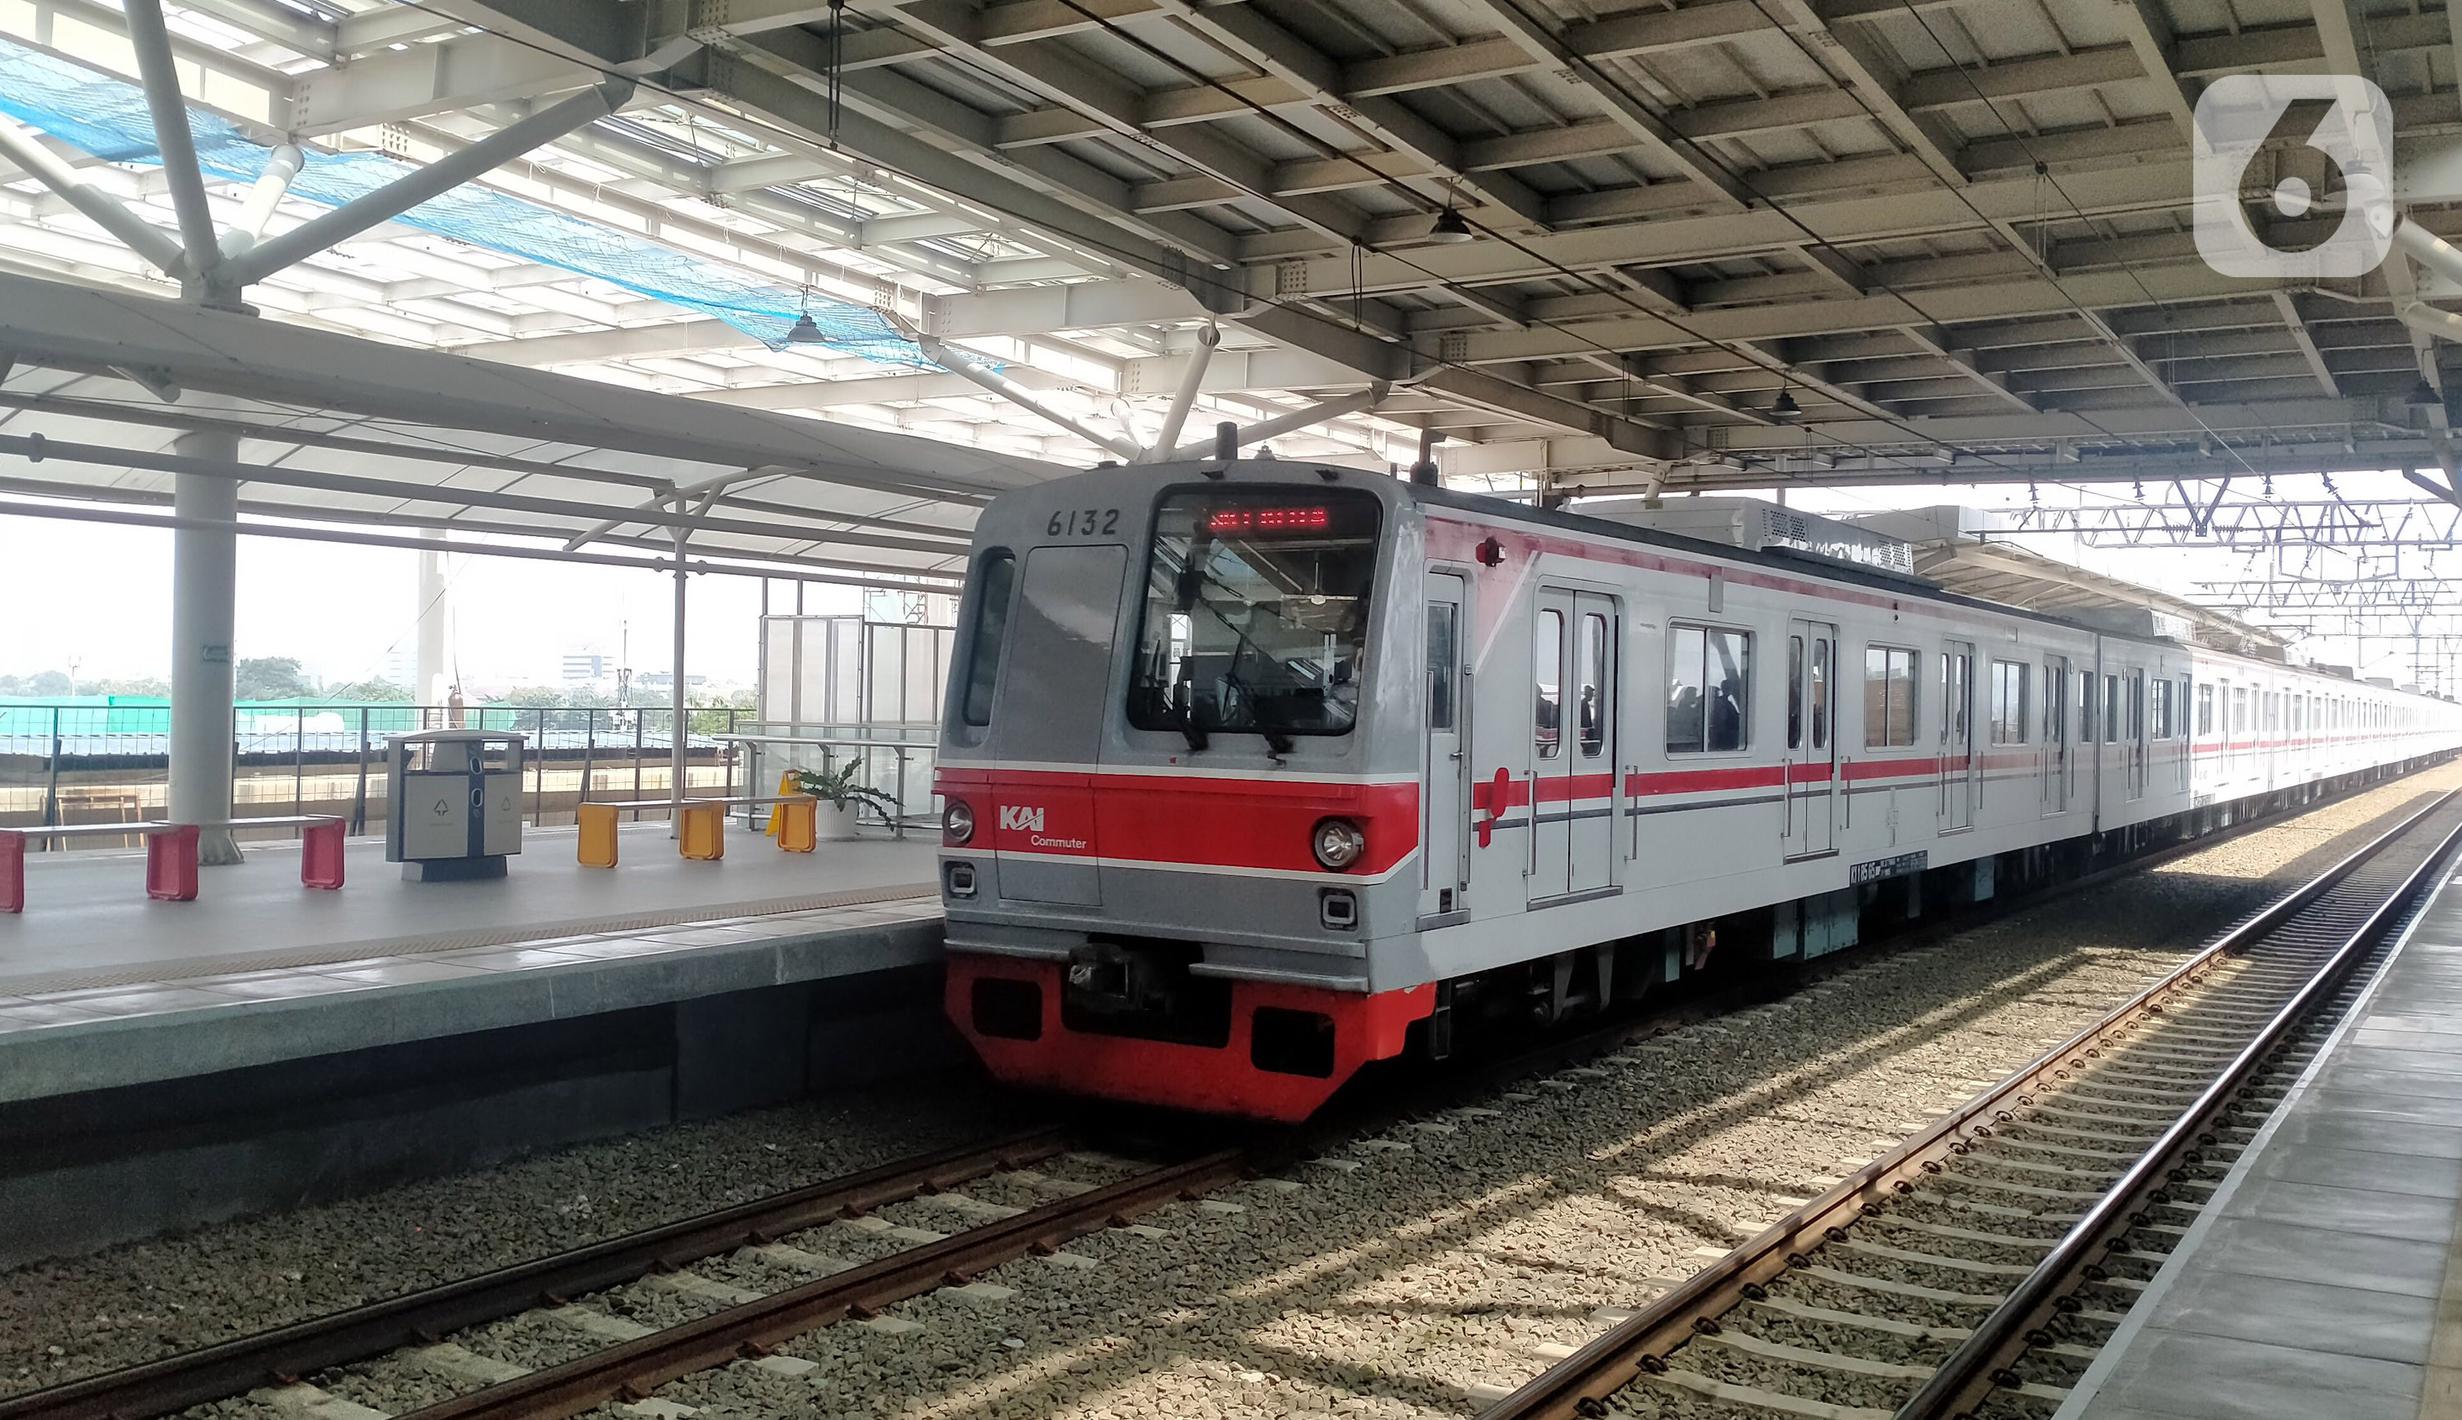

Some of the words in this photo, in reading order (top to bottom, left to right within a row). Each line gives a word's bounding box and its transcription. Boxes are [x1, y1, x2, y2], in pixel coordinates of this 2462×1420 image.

[1047, 508, 1120, 537] 6132
[1000, 805, 1045, 832] KAI
[1030, 834, 1087, 849] Commuter
